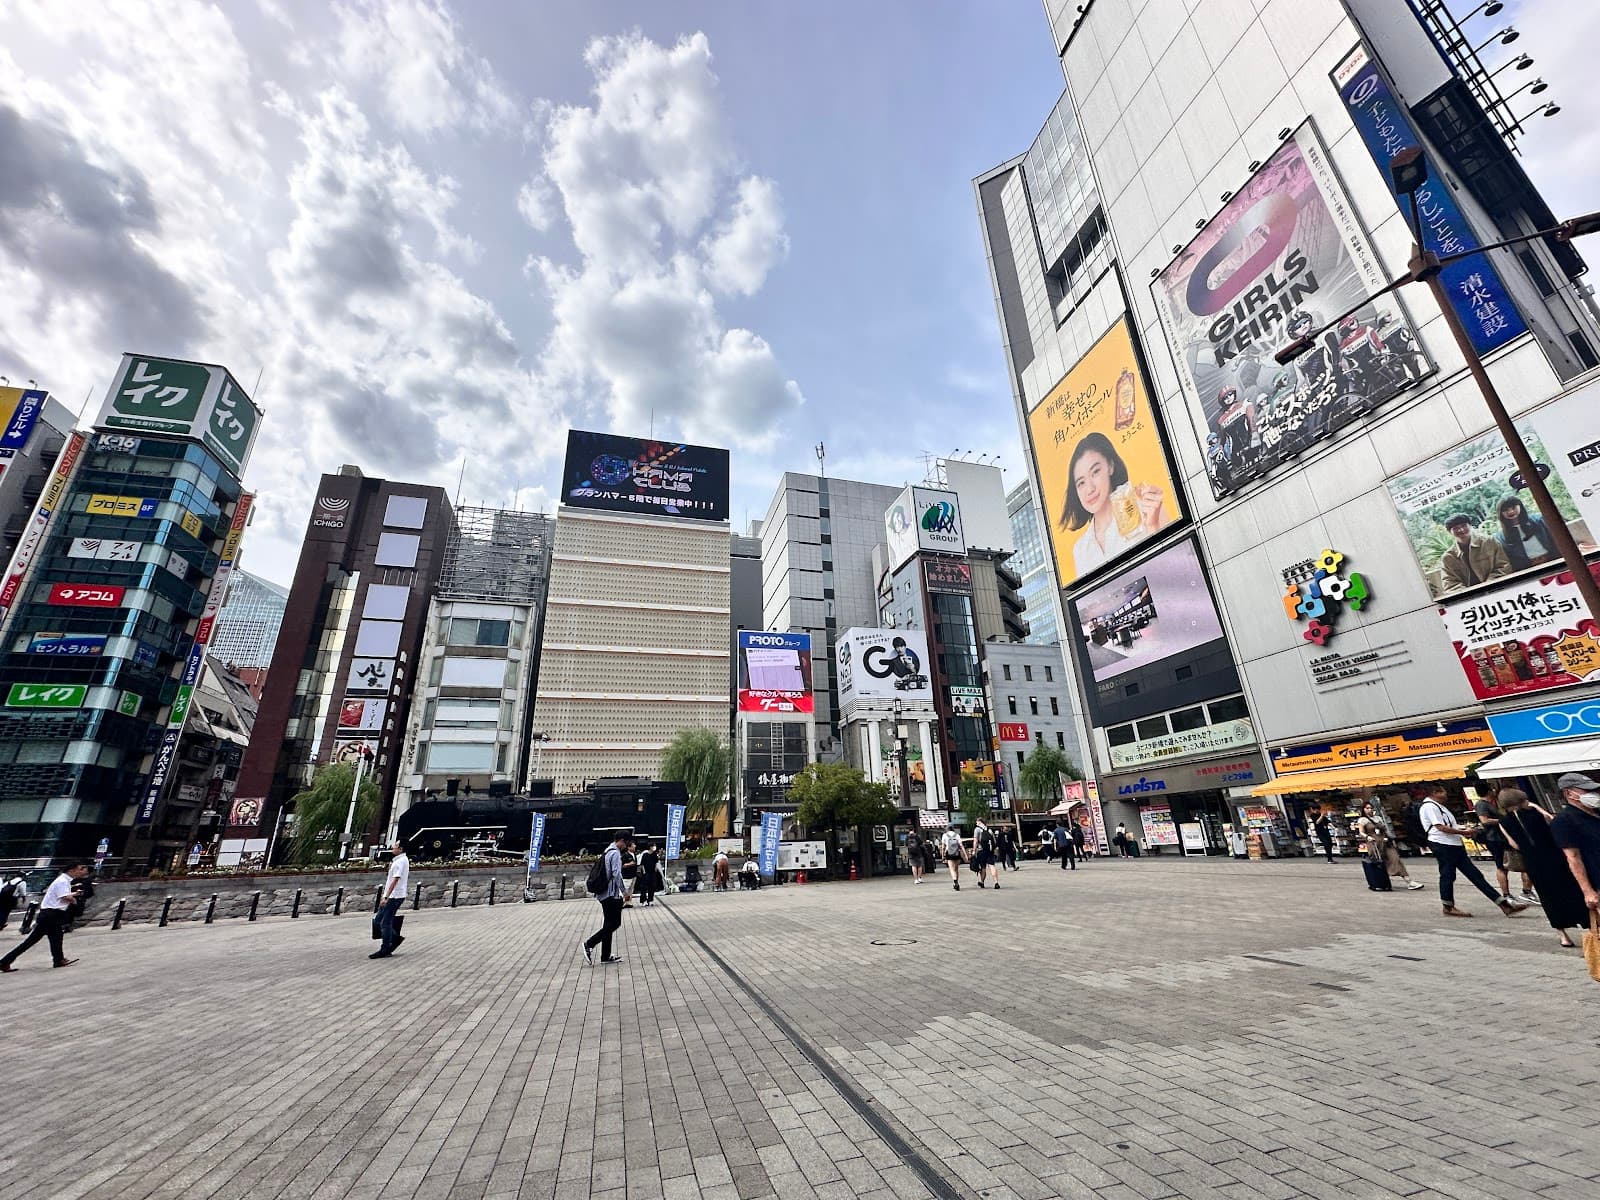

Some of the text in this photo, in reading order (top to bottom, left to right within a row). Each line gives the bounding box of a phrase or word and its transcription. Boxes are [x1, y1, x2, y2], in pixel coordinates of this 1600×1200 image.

[1208, 247, 1309, 344] GIRLS
[1459, 271, 1509, 338] 清水建設
[1214, 271, 1321, 368] KEIRIN
[132, 362, 162, 383] レ
[123, 384, 189, 407] イク
[1046, 391, 1071, 419] 新橋は
[1062, 383, 1097, 420] 幸せの
[215, 408, 245, 440] イク
[1053, 386, 1114, 448] 角ハイボール
[93, 499, 137, 512] プロミス
[313, 519, 344, 528] ICHIGO
[929, 534, 958, 543] GROUP
[75, 589, 114, 601] アコム
[1461, 592, 1554, 625] ダルい体に
[1467, 598, 1581, 637] スイッチ入れよう!
[36, 644, 90, 654] セントラル
[749, 635, 784, 645] PROTO
[19, 686, 75, 701] レイク
[1408, 736, 1482, 751] Matsumoto KiYoshi
